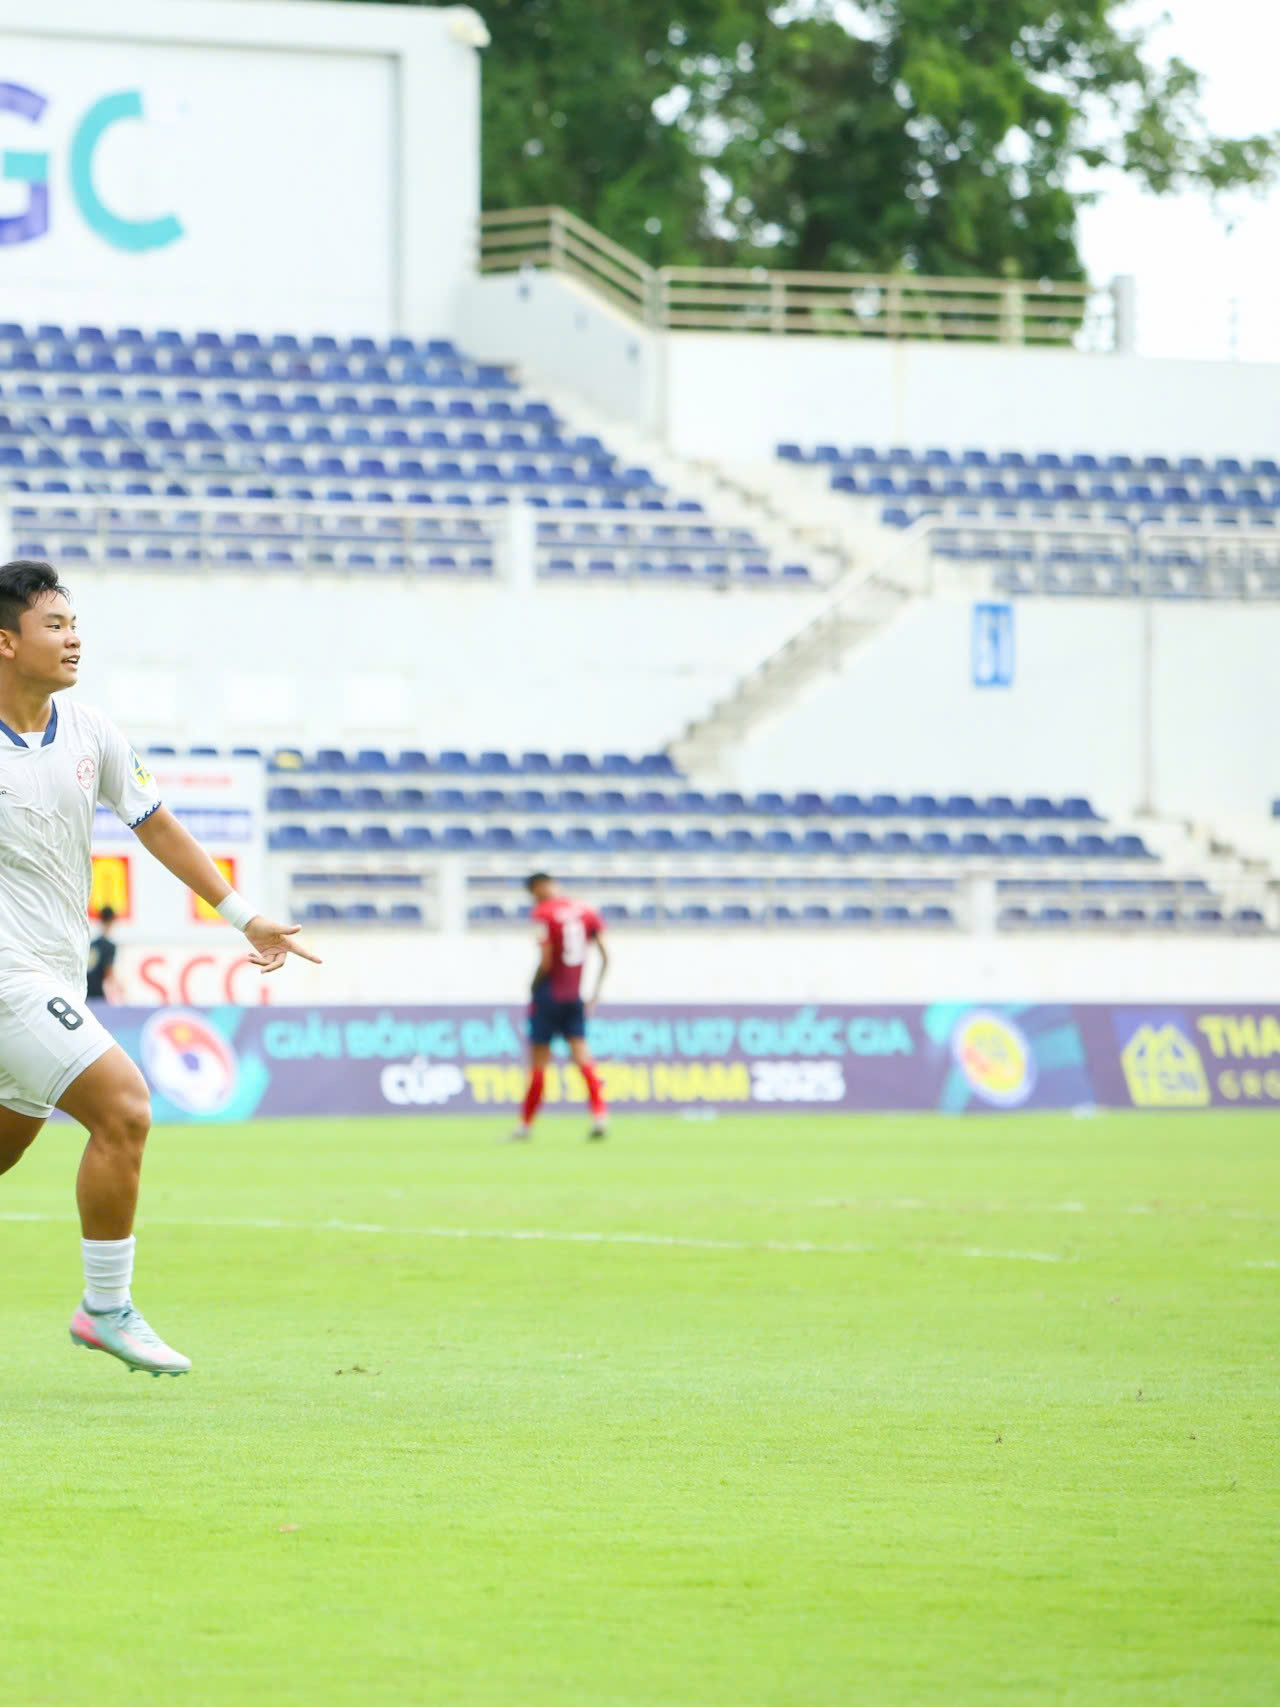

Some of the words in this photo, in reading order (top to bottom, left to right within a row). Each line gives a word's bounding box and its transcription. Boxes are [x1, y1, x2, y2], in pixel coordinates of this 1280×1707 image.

[47, 996, 84, 1031] 8
[846, 1017, 915, 1057] GIA
[380, 1055, 464, 1105] CÚP
